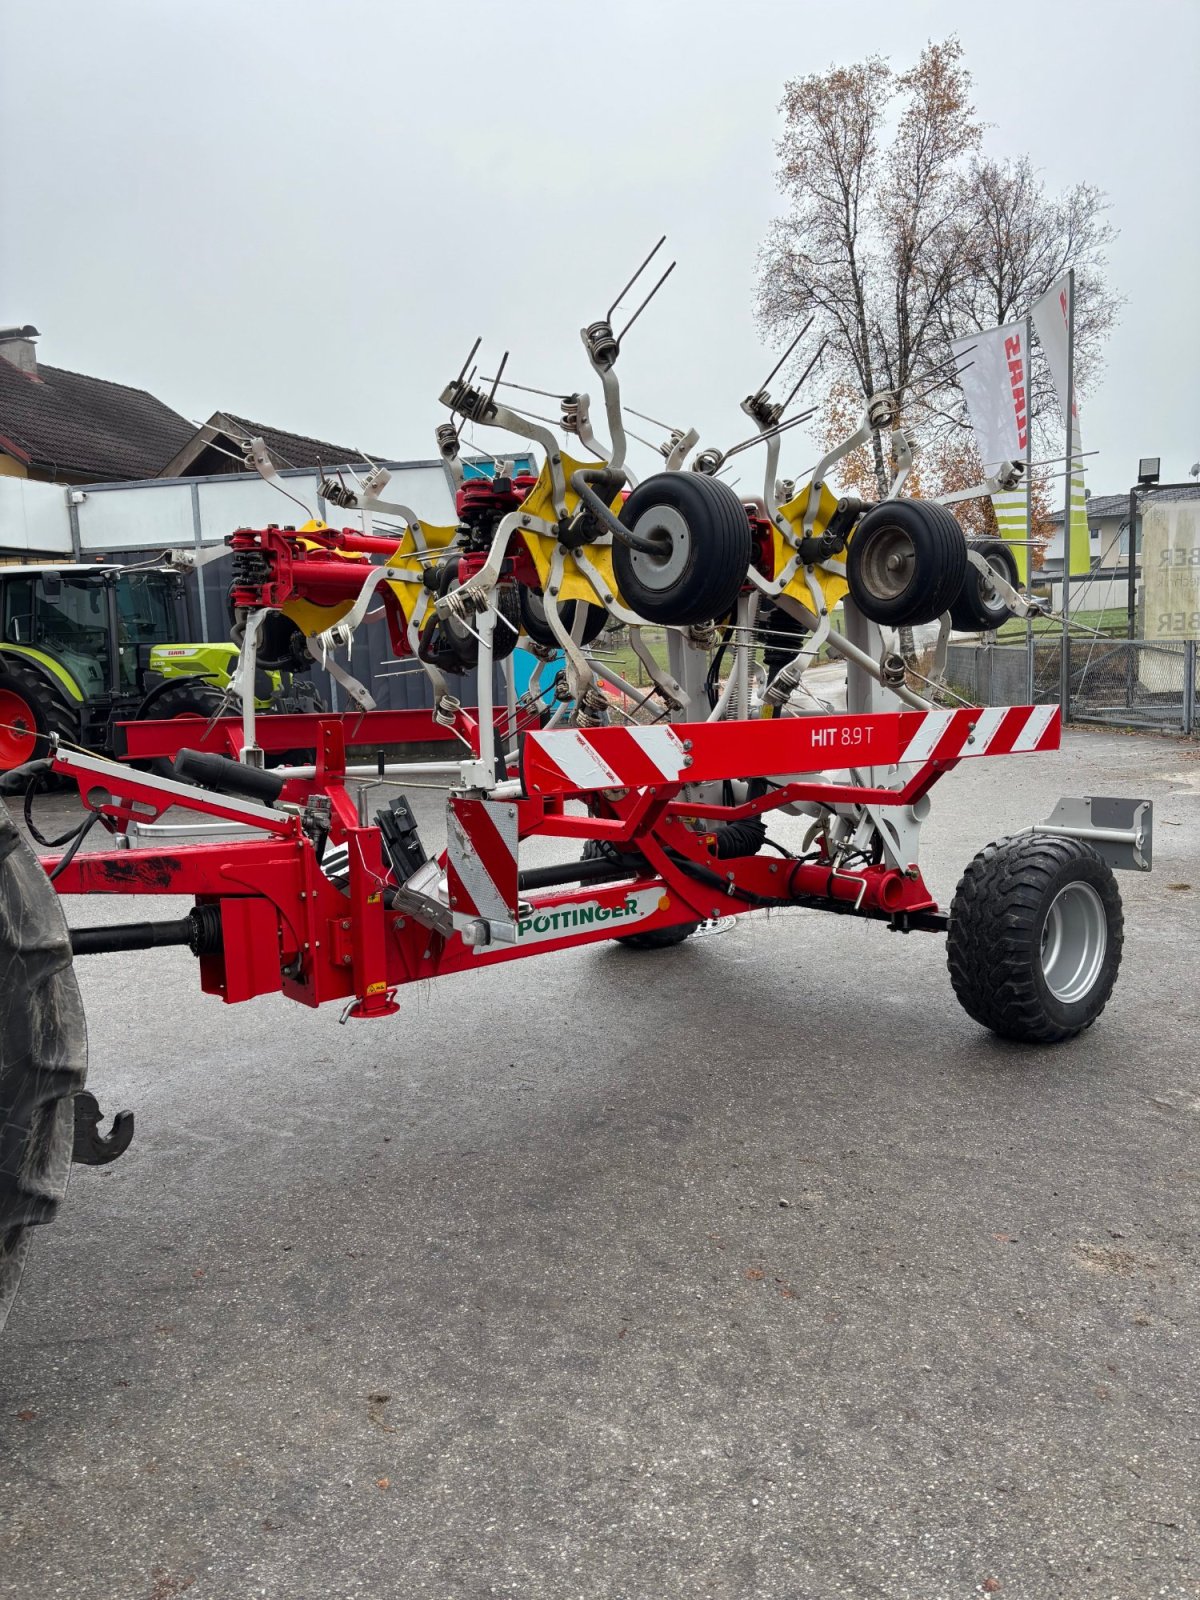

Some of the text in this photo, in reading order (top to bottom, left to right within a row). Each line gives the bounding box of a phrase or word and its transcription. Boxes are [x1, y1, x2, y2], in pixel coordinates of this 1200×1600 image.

[811, 726, 874, 747] HIT 8.9 T
